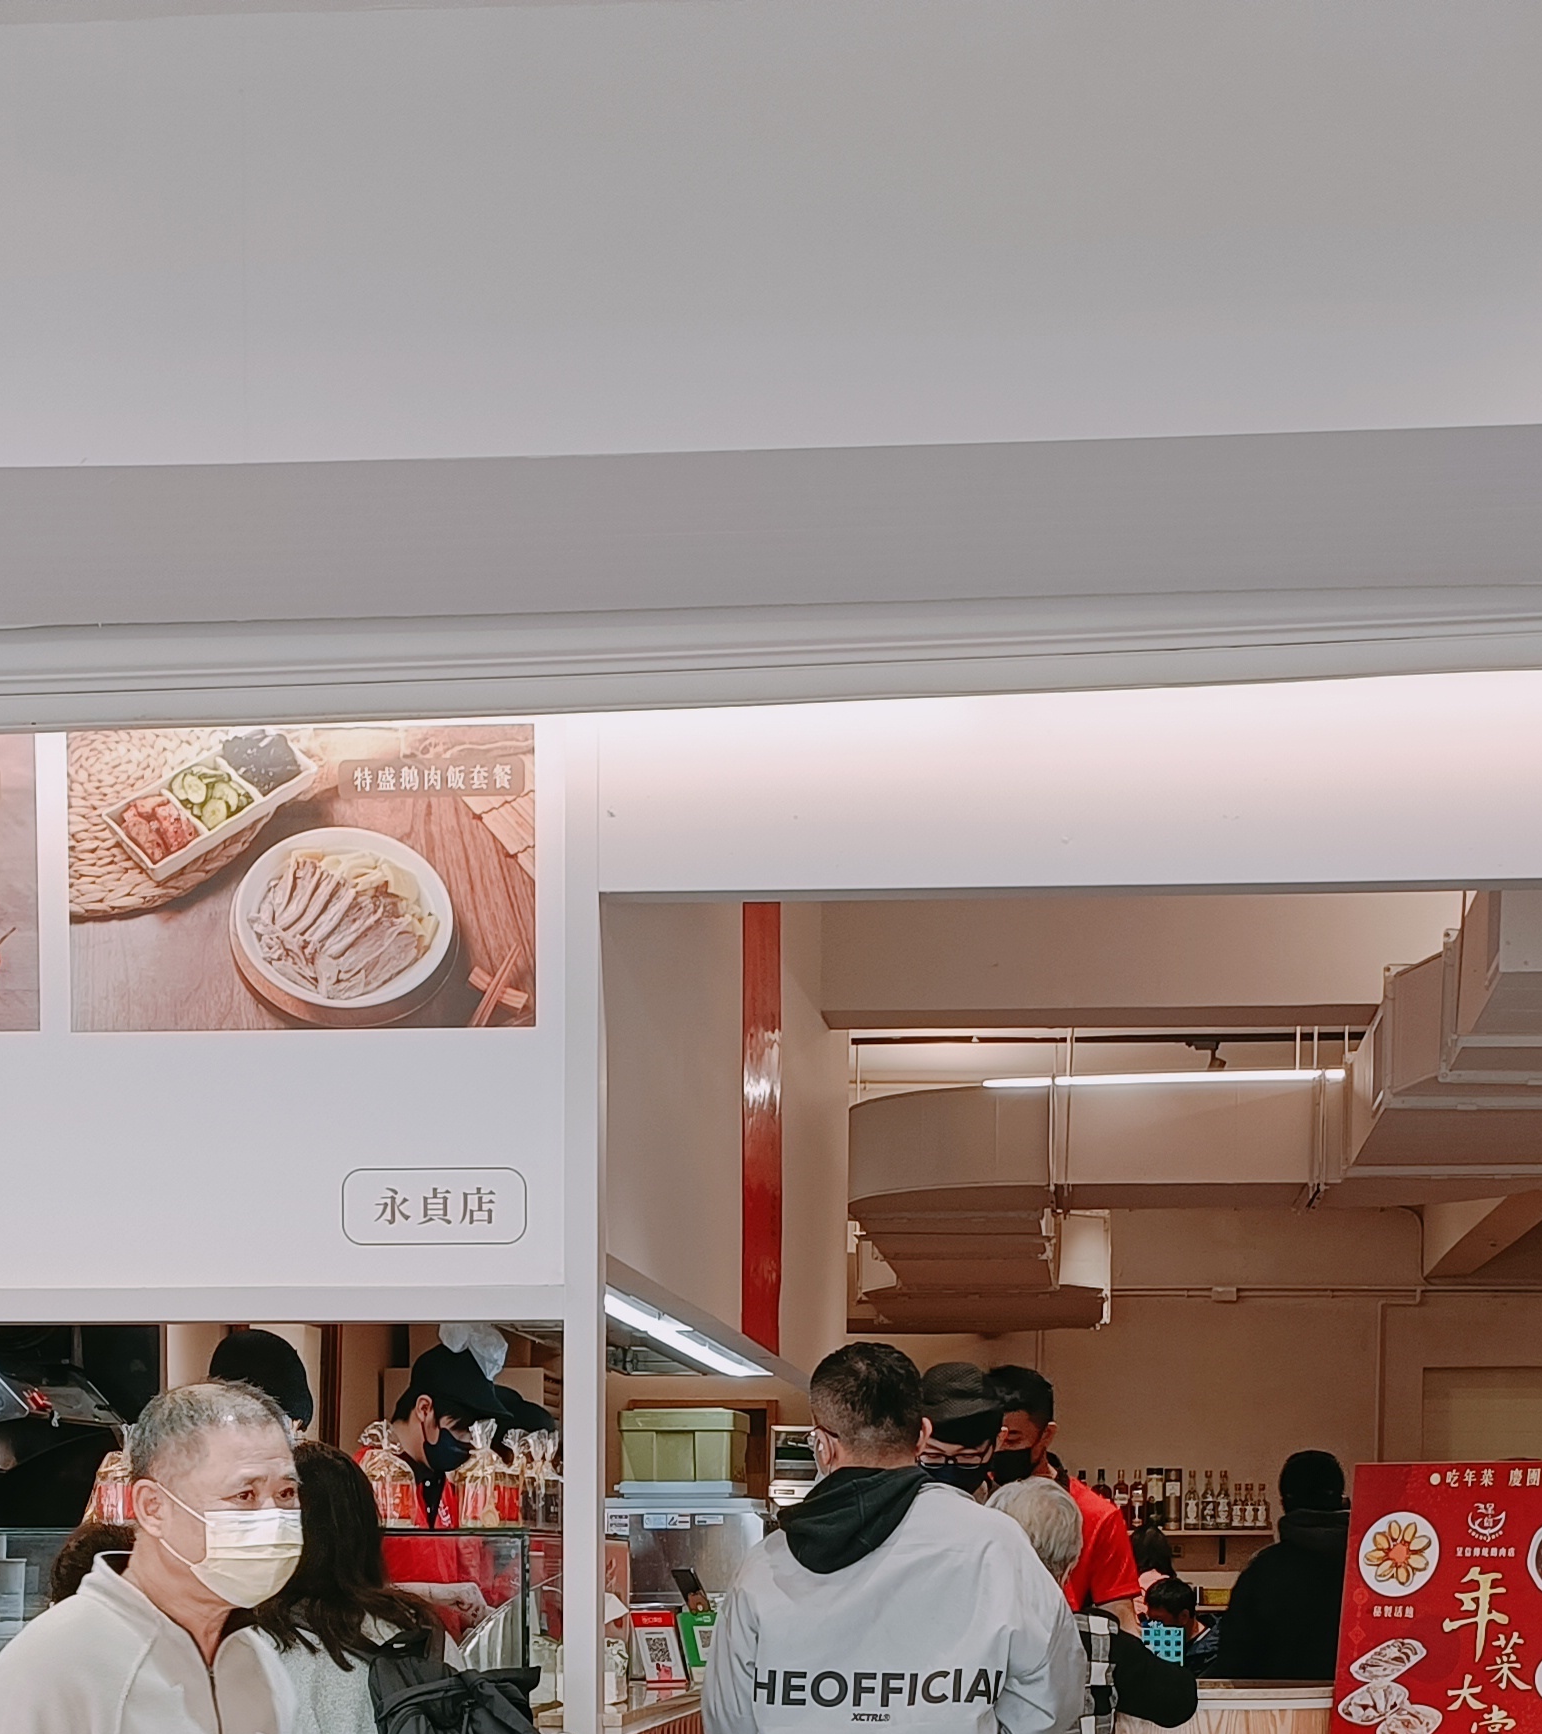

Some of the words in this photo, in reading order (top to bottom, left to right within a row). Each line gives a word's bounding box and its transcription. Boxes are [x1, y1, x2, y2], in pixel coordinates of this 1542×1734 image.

[352, 764, 514, 792] 特盛鵝肉飯套餐
[373, 1186, 497, 1226] 永貞店
[1446, 1468, 1495, 1487] 吃年菜
